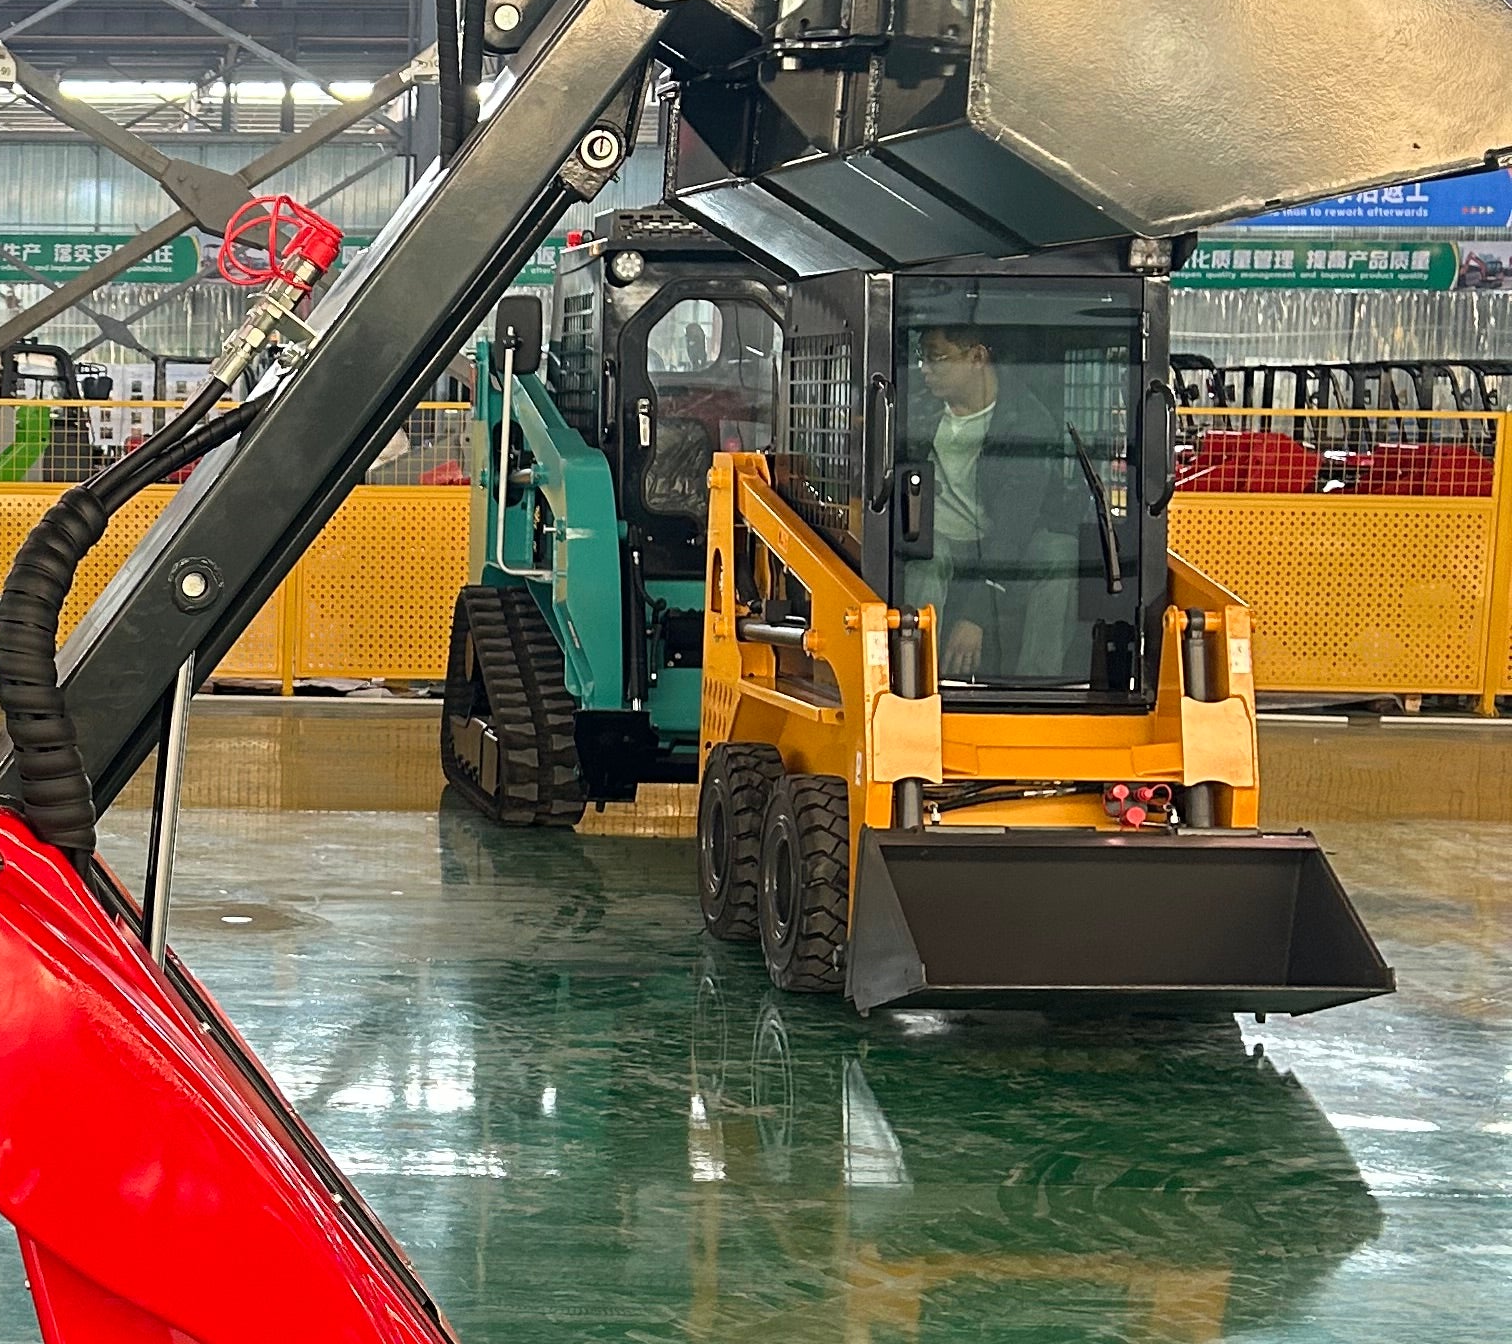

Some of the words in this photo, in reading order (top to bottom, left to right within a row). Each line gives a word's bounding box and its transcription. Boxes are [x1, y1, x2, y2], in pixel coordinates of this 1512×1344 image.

[1325, 207, 1364, 217] rework
[1367, 207, 1429, 217] afterwards
[54, 243, 174, 263] 落实安任
[1183, 250, 1295, 269] 化质量管理
